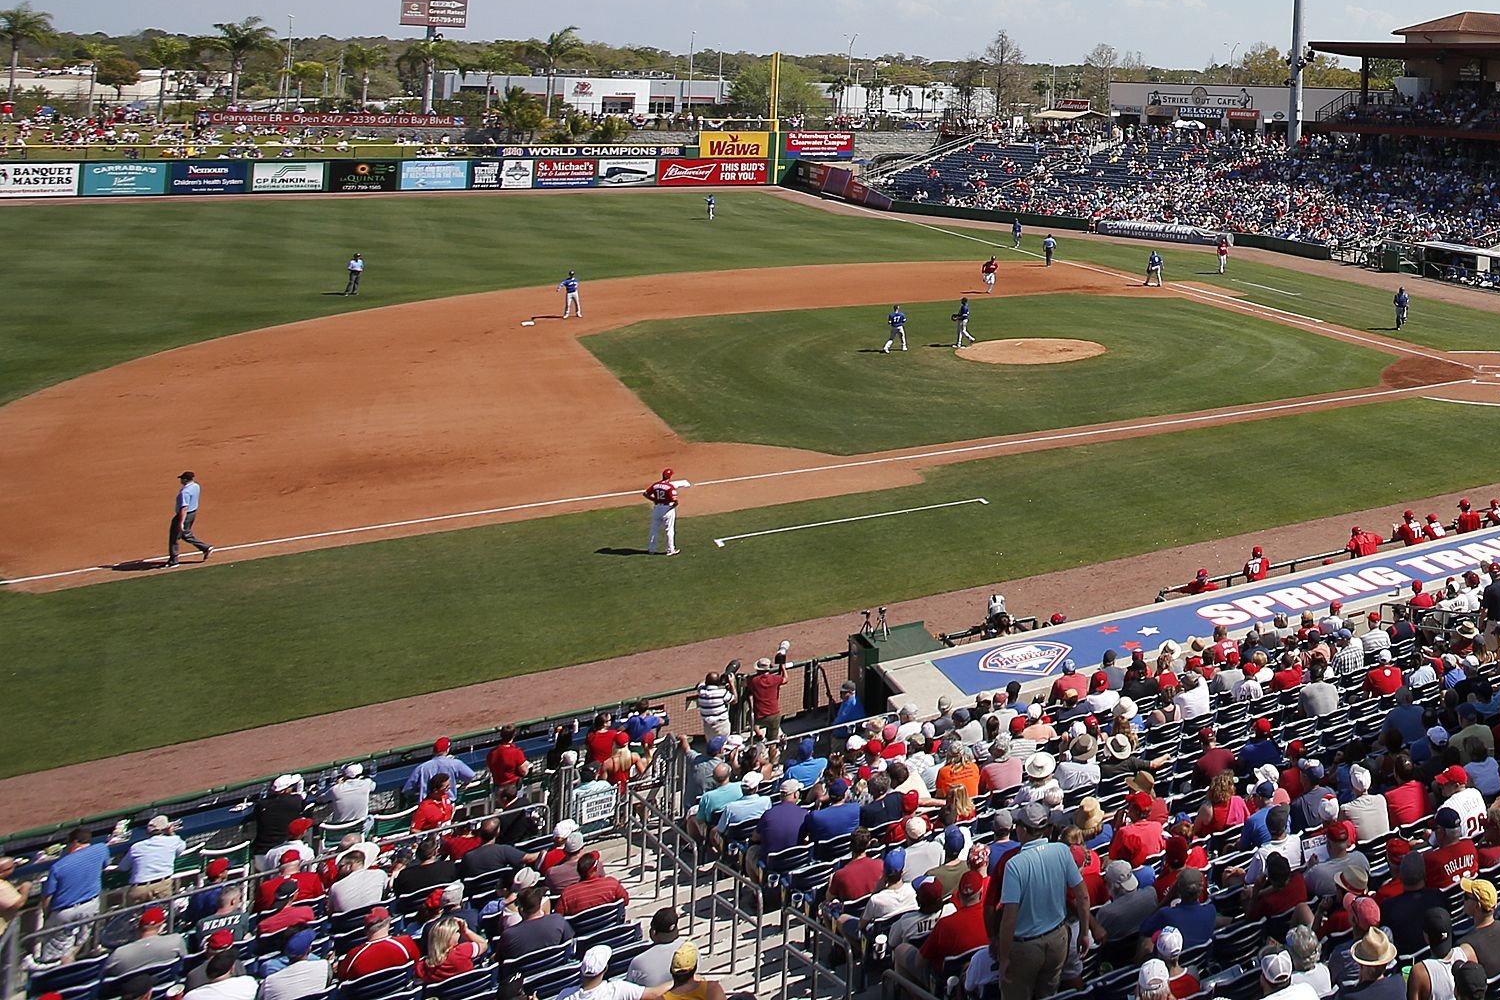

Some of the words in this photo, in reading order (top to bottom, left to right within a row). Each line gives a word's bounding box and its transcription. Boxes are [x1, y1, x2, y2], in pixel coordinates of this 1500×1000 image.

[1055, 101, 1088, 110] Budweiser
[1163, 96, 1188, 104] STRIKE
[1217, 98, 1236, 106] CAFE
[213, 113, 266, 122] Clearwater
[269, 114, 282, 122] ER
[292, 114, 320, 124] Open
[321, 115, 343, 124] 24/7
[352, 115, 376, 124] 2339
[377, 116, 397, 124] Gulf
[411, 116, 428, 126] Bay
[429, 116, 452, 125] Blvd.
[528, 147, 577, 156] WORLD
[581, 147, 657, 156] CHAMPIONS
[709, 140, 760, 156] Wawa
[93, 165, 157, 174] CARRABBA'S
[188, 165, 229, 174] Nemours
[538, 162, 550, 171] St.
[552, 161, 594, 171] Michael's
[720, 163, 740, 171] THIS
[740, 162, 765, 171] BUD'S
[13, 167, 73, 176] BANQUET
[667, 167, 711, 177] Budweiser
[720, 172, 736, 180] FOR
[737, 172, 757, 180] YOU.
[12, 177, 73, 185] MASTERS
[1106, 221, 1164, 232] COUNTRYSIDE
[656, 490, 666, 500] 12
[1248, 563, 1260, 575] 70
[1196, 564, 1414, 626] SPRING
[991, 648, 1058, 668] Phillies
[1443, 854, 1475, 876] ROLLINS
[202, 914, 241, 932] WENTZ
